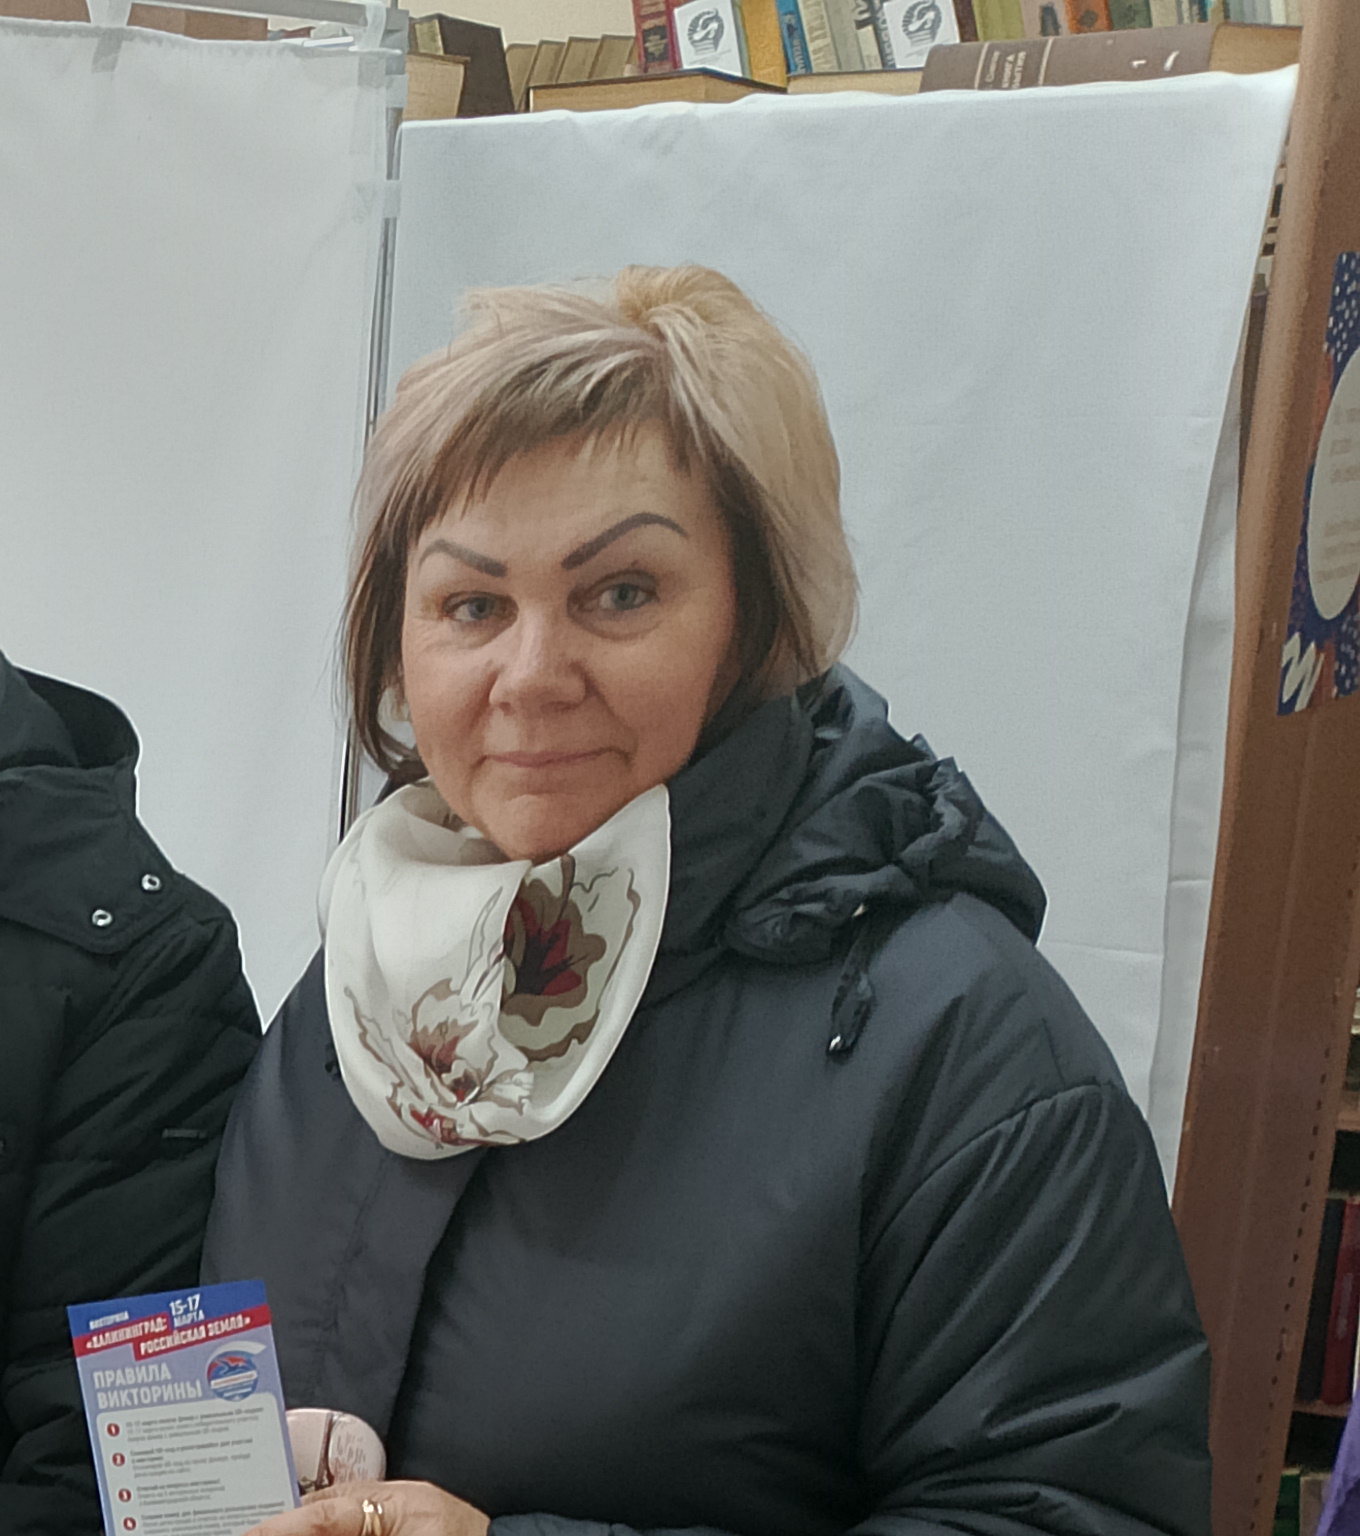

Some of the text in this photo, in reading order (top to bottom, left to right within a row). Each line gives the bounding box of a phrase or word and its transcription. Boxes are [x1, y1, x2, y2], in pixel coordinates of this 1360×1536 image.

[169, 1294, 201, 1315] 15-17
[86, 1317, 168, 1349] «КАЛИНИНГРАД:
[140, 1314, 251, 1355] РОССИЙСКАЯ ЗЕМЛЯ»
[93, 1362, 171, 1389] ПРАВИЛА
[97, 1379, 203, 1410] ВИКТОРИНЫ
